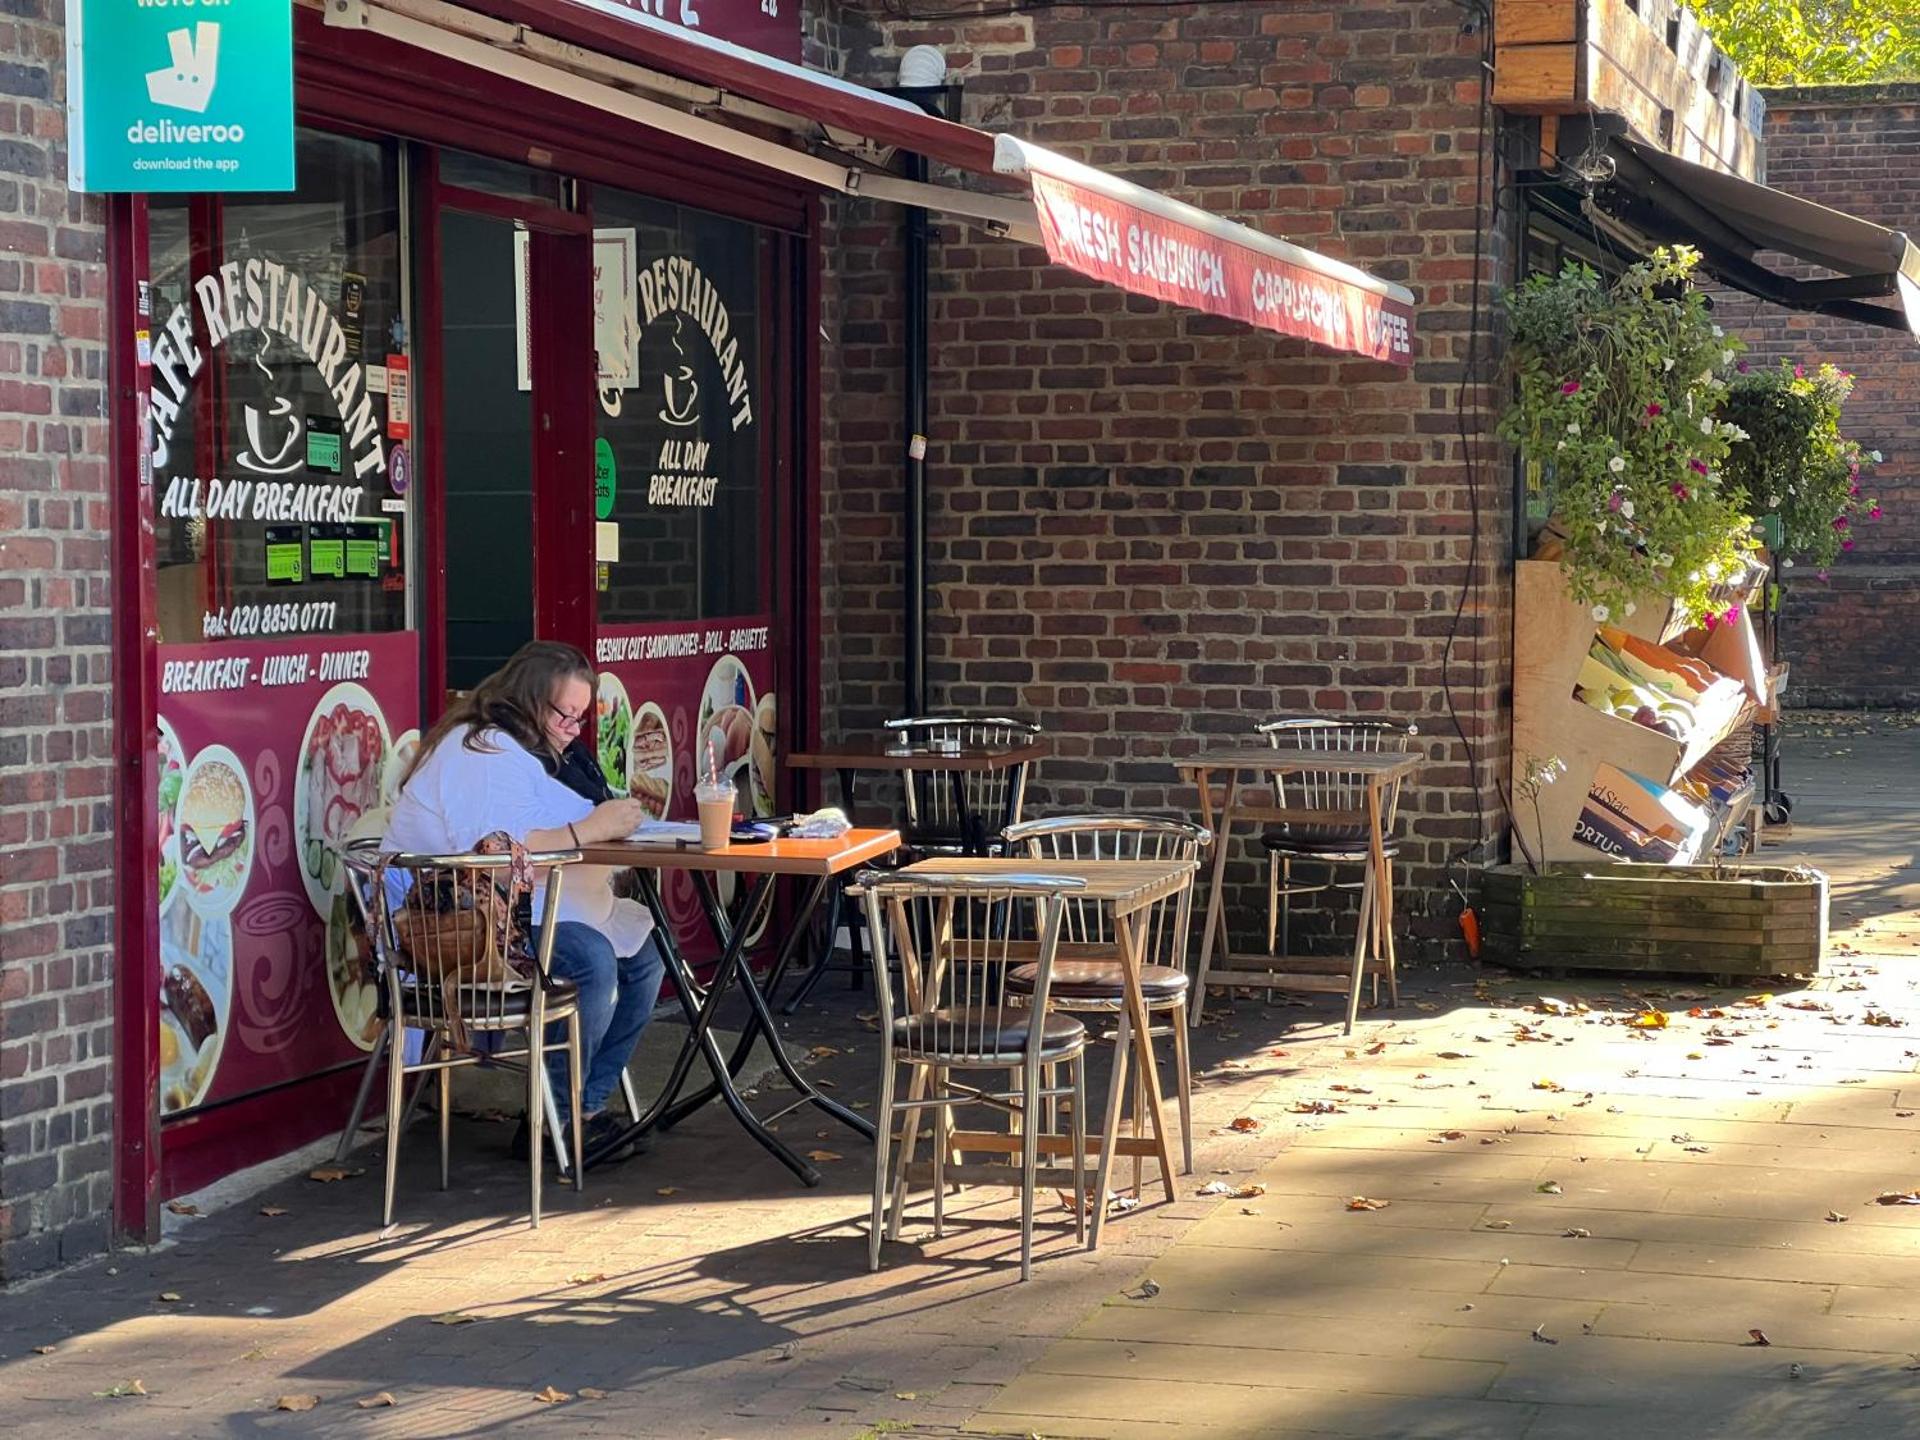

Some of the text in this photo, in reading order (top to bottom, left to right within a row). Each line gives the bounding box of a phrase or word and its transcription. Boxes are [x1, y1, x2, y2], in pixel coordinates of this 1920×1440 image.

[127, 119, 243, 144] deliveroo
[132, 156, 239, 173] download the app
[1127, 224, 1226, 299] SANDWICH
[638, 255, 752, 432] RESTAURANT
[195, 257, 386, 479] RESTAURANT
[658, 438, 710, 472] ALL DAY
[161, 475, 363, 523] ALL DAY BREAKFAST
[648, 474, 719, 507] BREAKFAST
[229, 604, 260, 636] 020
[260, 602, 299, 634] 8856
[300, 601, 336, 632] 0771
[627, 635, 647, 661] CUT
[645, 632, 699, 660] SANDWICHES
[704, 630, 723, 654] ROLL
[728, 626, 769, 652] BAGUETTE
[162, 649, 370, 693] BREAKFAST LUNCH DINNER
